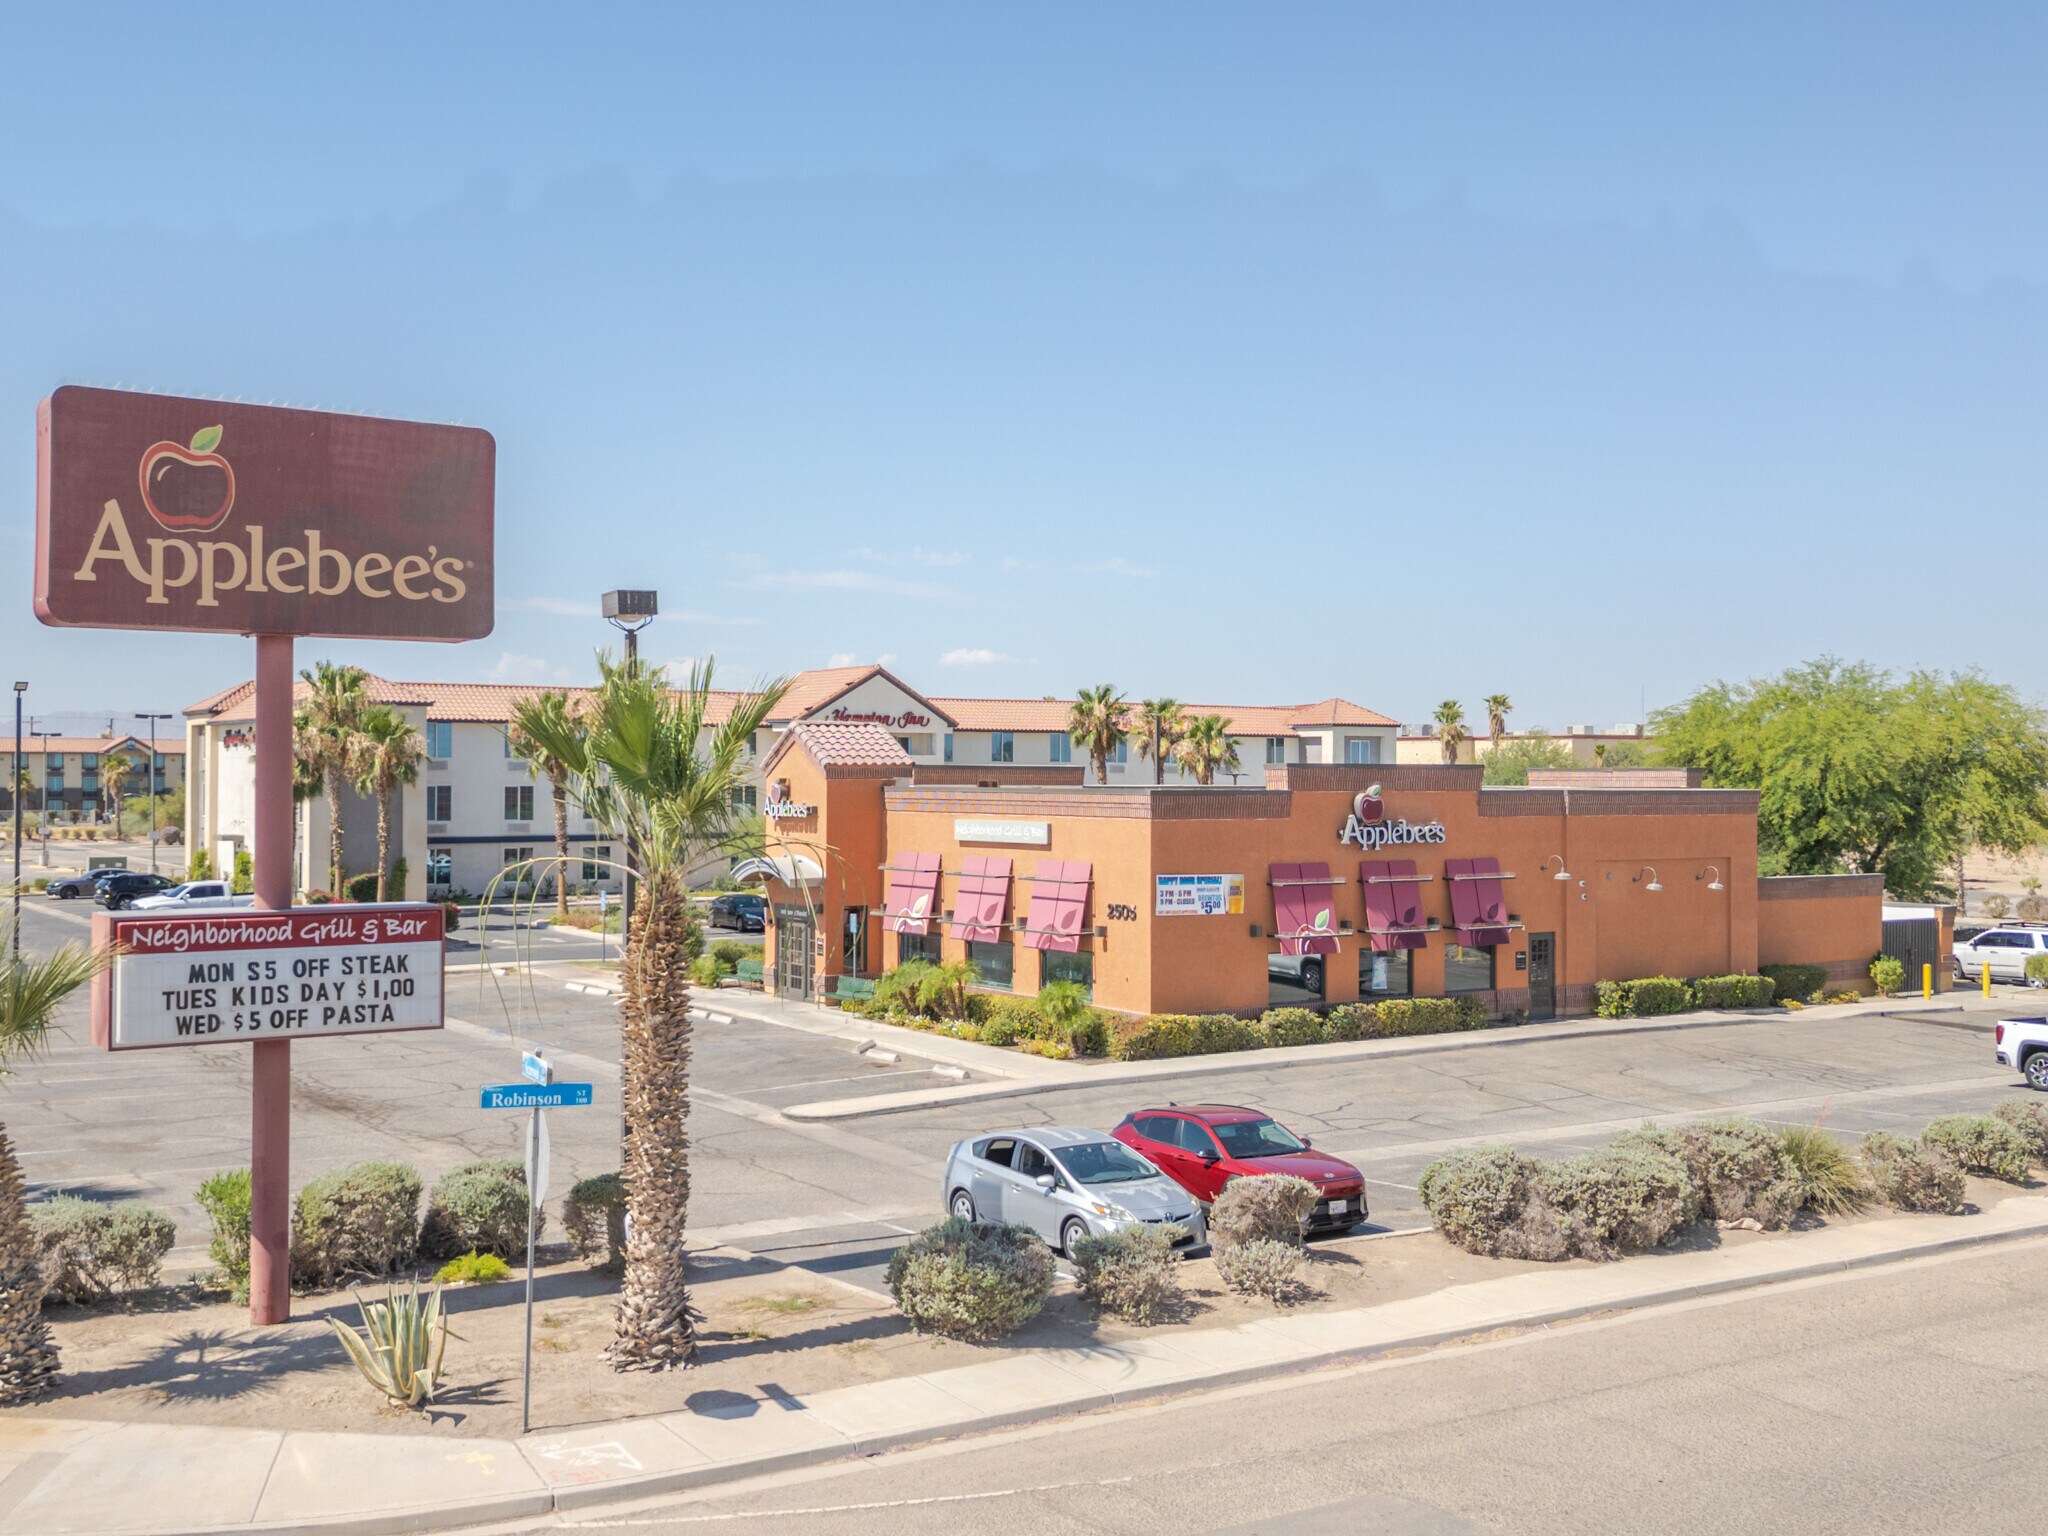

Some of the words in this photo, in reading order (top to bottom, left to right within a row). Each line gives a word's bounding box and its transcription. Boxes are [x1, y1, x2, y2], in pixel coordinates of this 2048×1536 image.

[74, 499, 467, 607] Applebee's
[897, 711, 930, 728] Inn
[1340, 814, 1446, 851] Applebee's
[132, 919, 294, 952] Neighborhood
[300, 917, 356, 944] Grill
[361, 919, 379, 942] &
[383, 918, 427, 936] Bar
[188, 962, 234, 983] MON
[293, 958, 329, 978] OFF
[341, 954, 408, 975] STEAK
[162, 988, 216, 1010] TUES
[232, 984, 289, 1006] KIDS
[301, 982, 345, 1002] DAY
[176, 1013, 221, 1035] WED
[234, 1010, 262, 1032] $5
[270, 1009, 308, 1029] OFF
[323, 1004, 394, 1026] PASTA
[491, 1092, 562, 1107] Robinson
